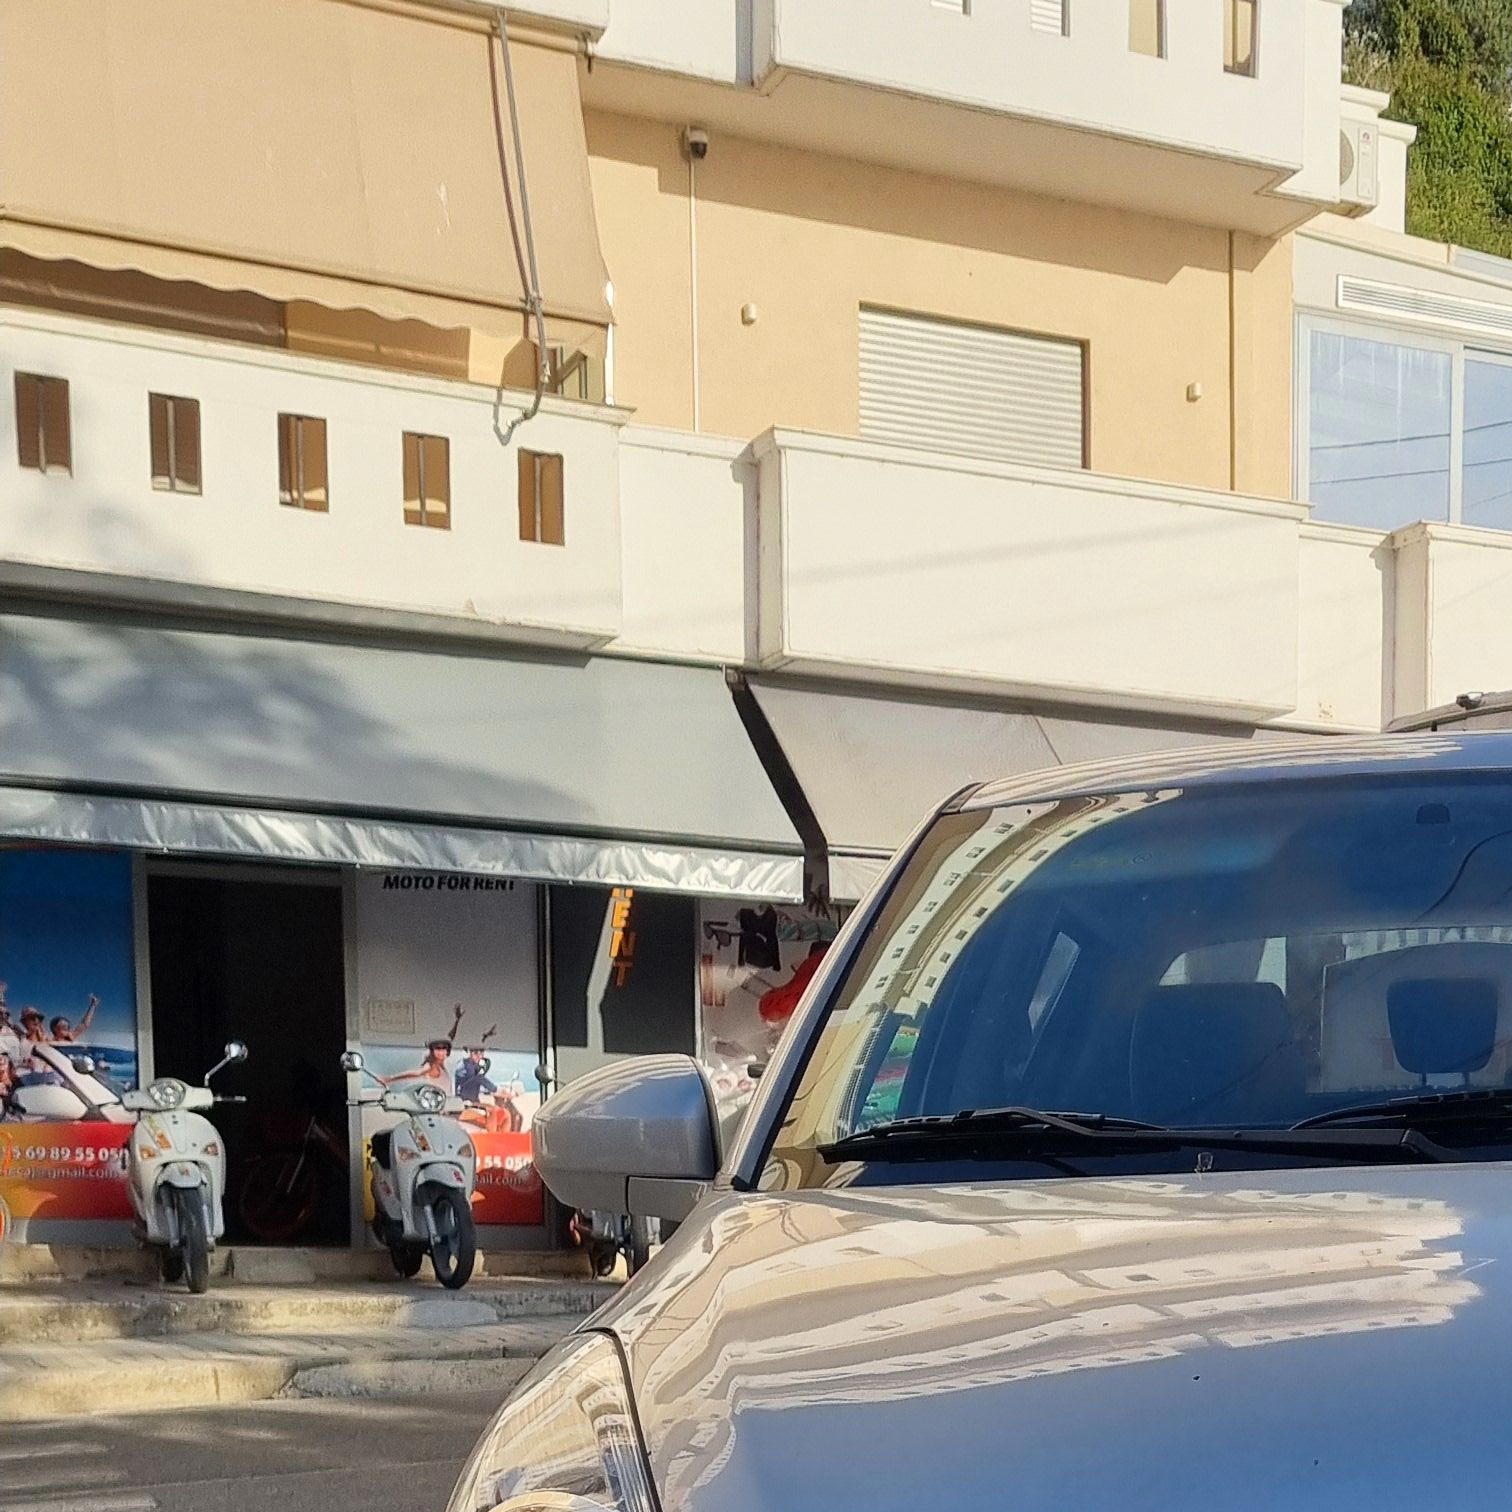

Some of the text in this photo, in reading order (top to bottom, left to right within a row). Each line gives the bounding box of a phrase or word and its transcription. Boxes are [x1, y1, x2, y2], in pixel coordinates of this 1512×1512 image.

[383, 875, 434, 890] MOTO
[437, 876, 470, 890] FOR
[26, 1146, 46, 1160] 69
[50, 1146, 71, 1160] 89
[75, 1146, 95, 1161] 55
